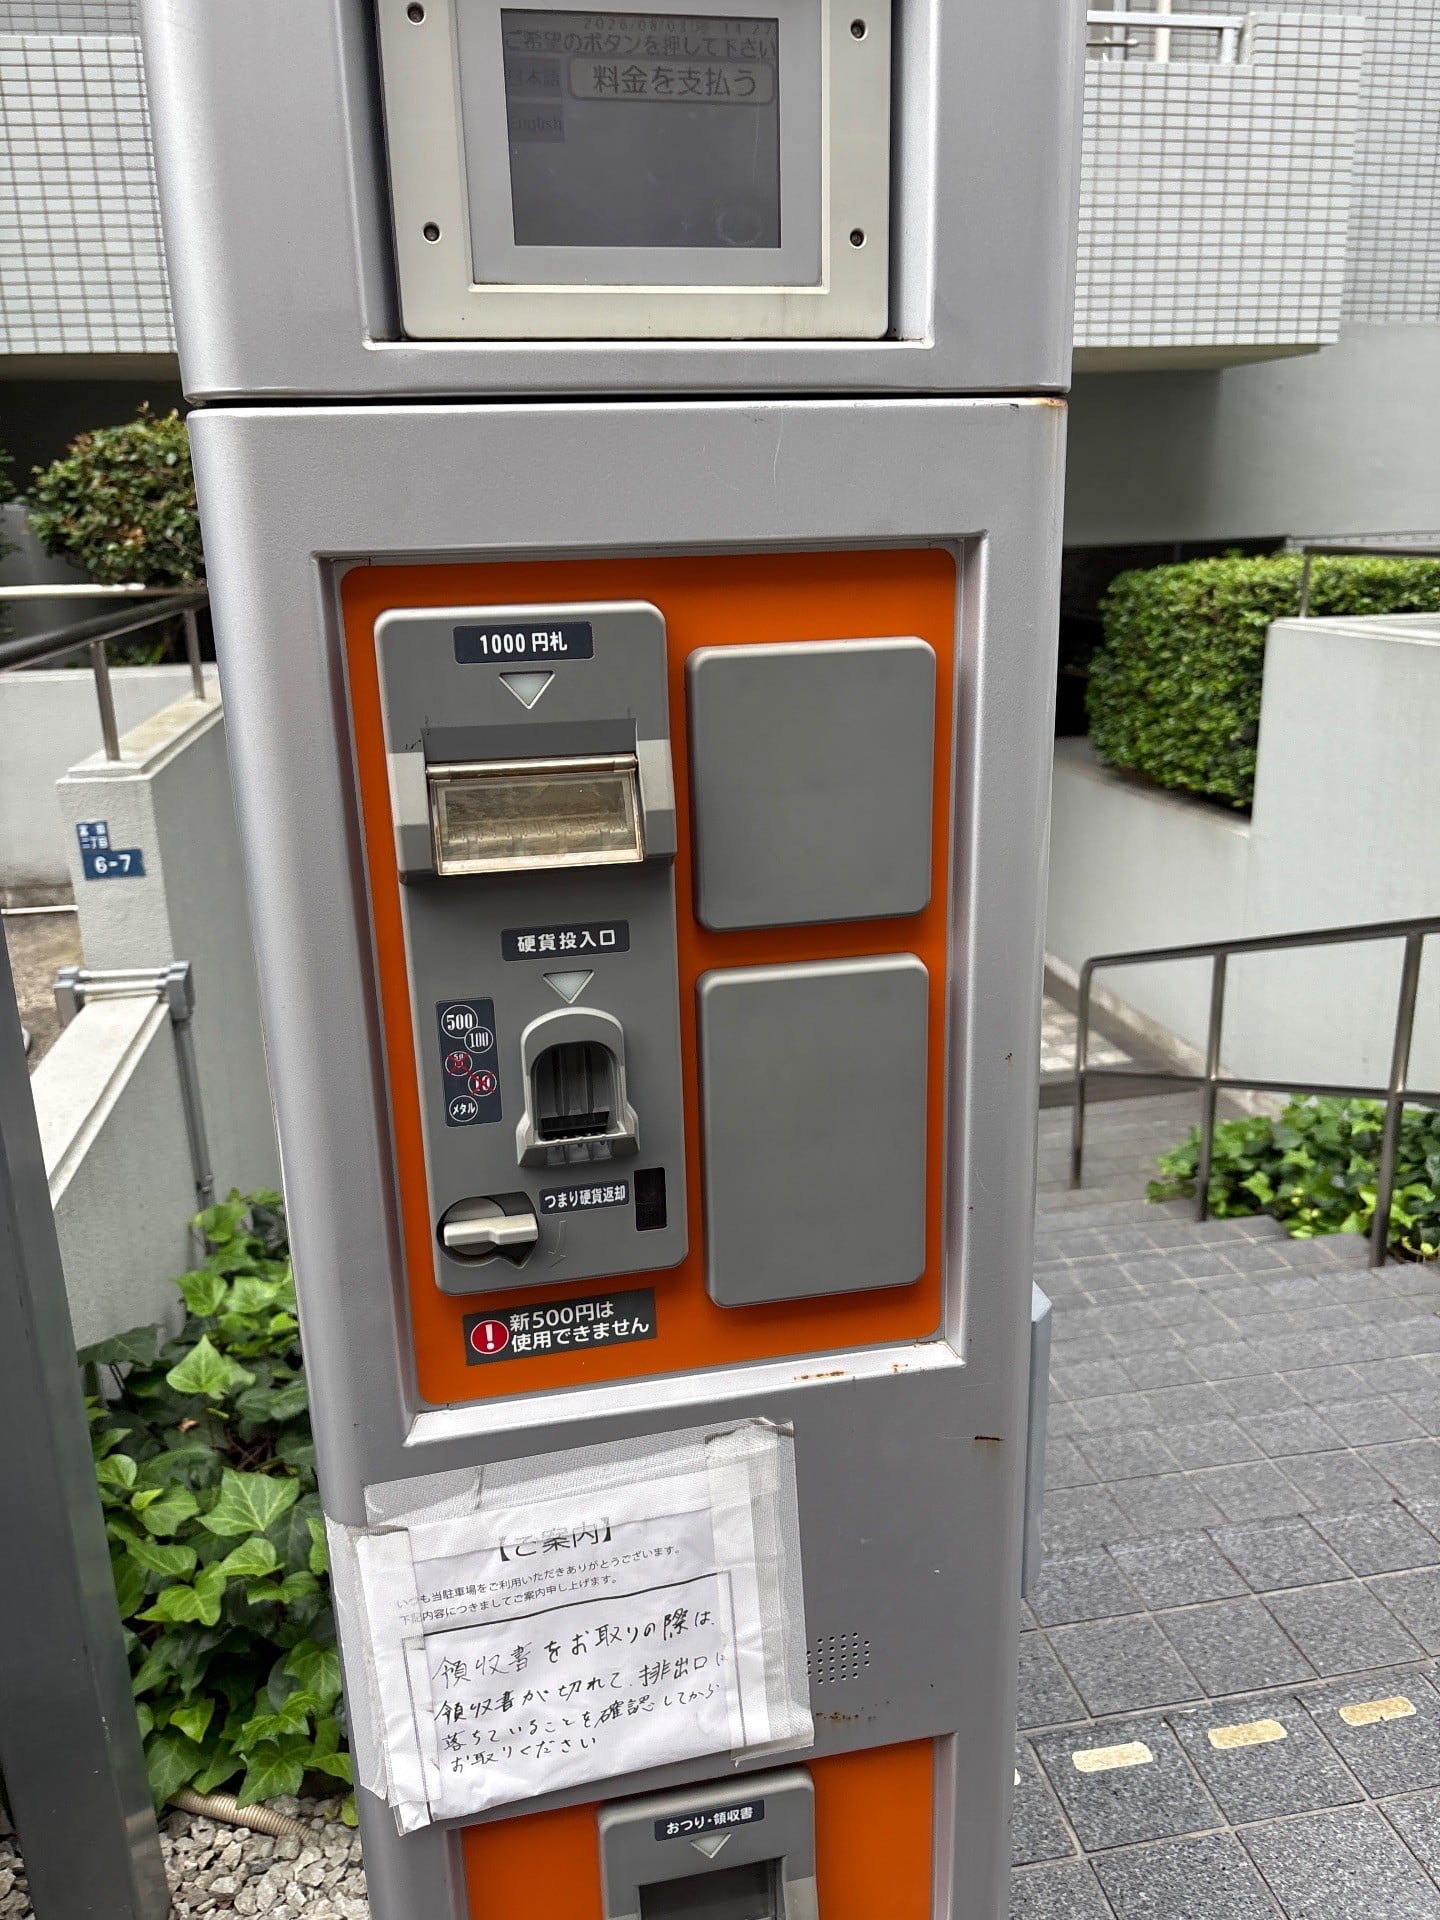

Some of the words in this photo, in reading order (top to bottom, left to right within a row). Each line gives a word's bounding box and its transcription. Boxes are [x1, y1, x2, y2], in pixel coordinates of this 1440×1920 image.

[593, 64, 756, 97] 料金を支払う
[480, 633, 526, 655] 1000
[532, 631, 568, 652] 円札
[94, 853, 131, 874] 6-7
[517, 929, 616, 953] 硬貨投入口
[446, 1012, 473, 1031] 500
[469, 1031, 489, 1049] 100
[452, 1102, 476, 1116] メタル
[544, 1185, 627, 1209] つまり硬貨返却
[509, 1301, 615, 1333] 新500円は
[511, 1317, 650, 1353] 使用できません
[499, 1517, 611, 1562] 【ご案内】
[441, 1683, 720, 1751] 落ちていることを確認してから
[450, 1736, 597, 1773] お取りください
[666, 1806, 754, 1835] おつり・領収書
